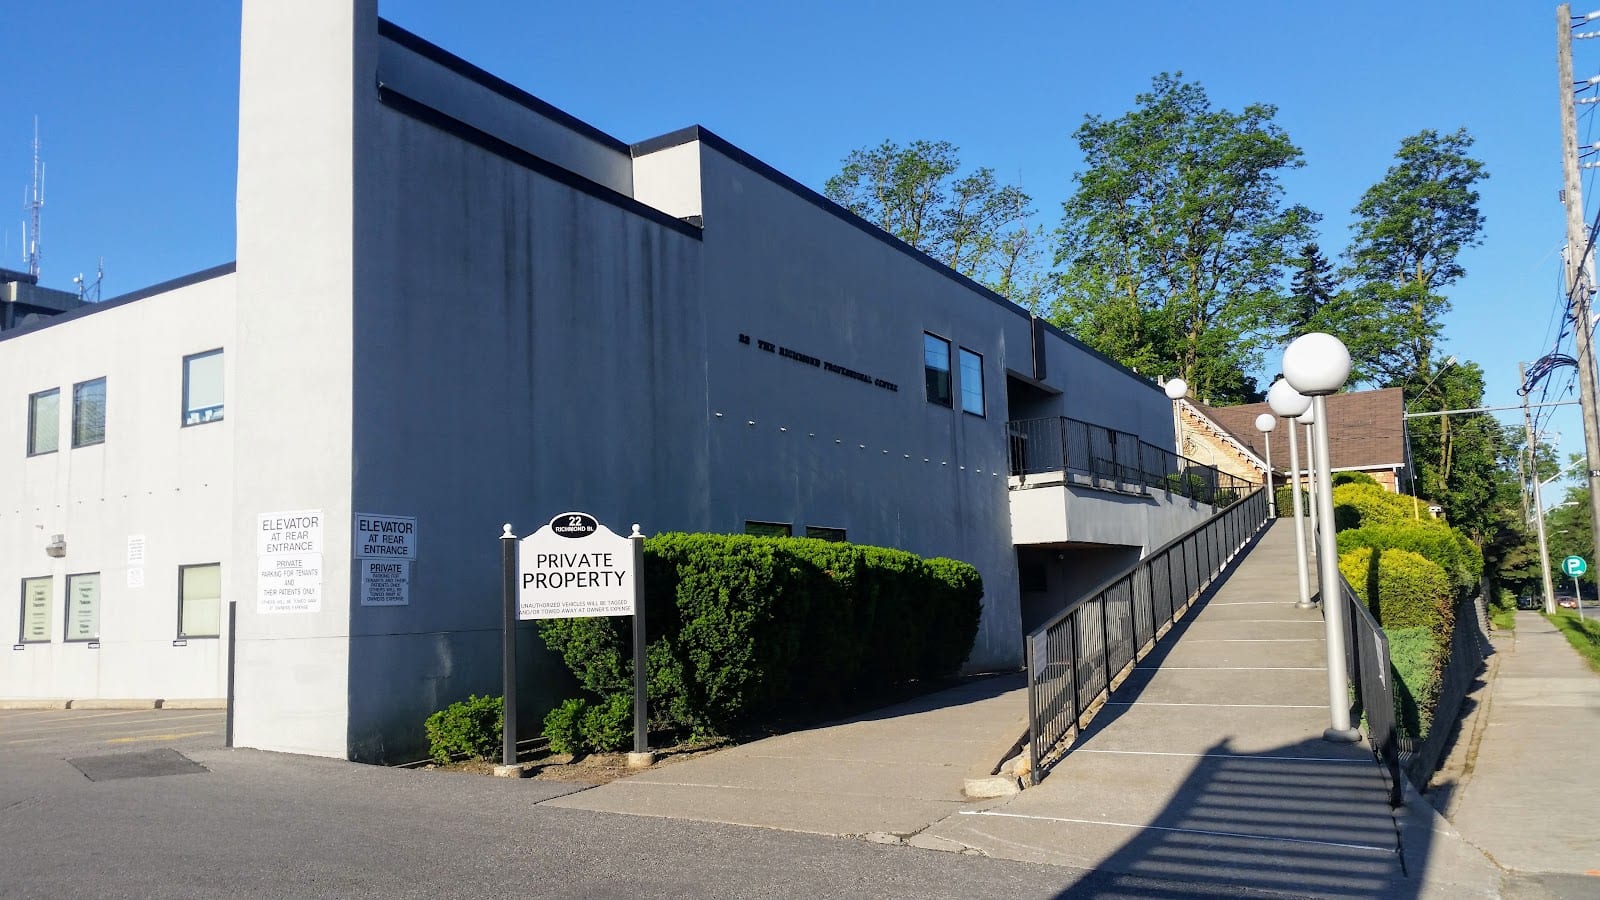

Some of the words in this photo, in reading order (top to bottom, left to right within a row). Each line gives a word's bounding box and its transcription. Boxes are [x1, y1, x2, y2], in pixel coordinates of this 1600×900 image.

[758, 339, 775, 353] THE
[779, 347, 820, 368] RICHMOND
[824, 361, 872, 384] PROFESSIONAL
[262, 516, 319, 531] ELEVATOR
[568, 516, 582, 526] 22
[360, 520, 413, 534] ELEVATOR
[271, 532, 281, 541] AT
[286, 530, 309, 540] REAR
[368, 534, 378, 543] AT
[383, 535, 404, 544] REAR
[266, 541, 313, 552] ENTRANCE
[364, 545, 408, 555] ENTRANCE
[537, 553, 613, 568] PRIVATE
[370, 564, 402, 573] PRIVATE
[523, 570, 626, 589] PROPERTY
